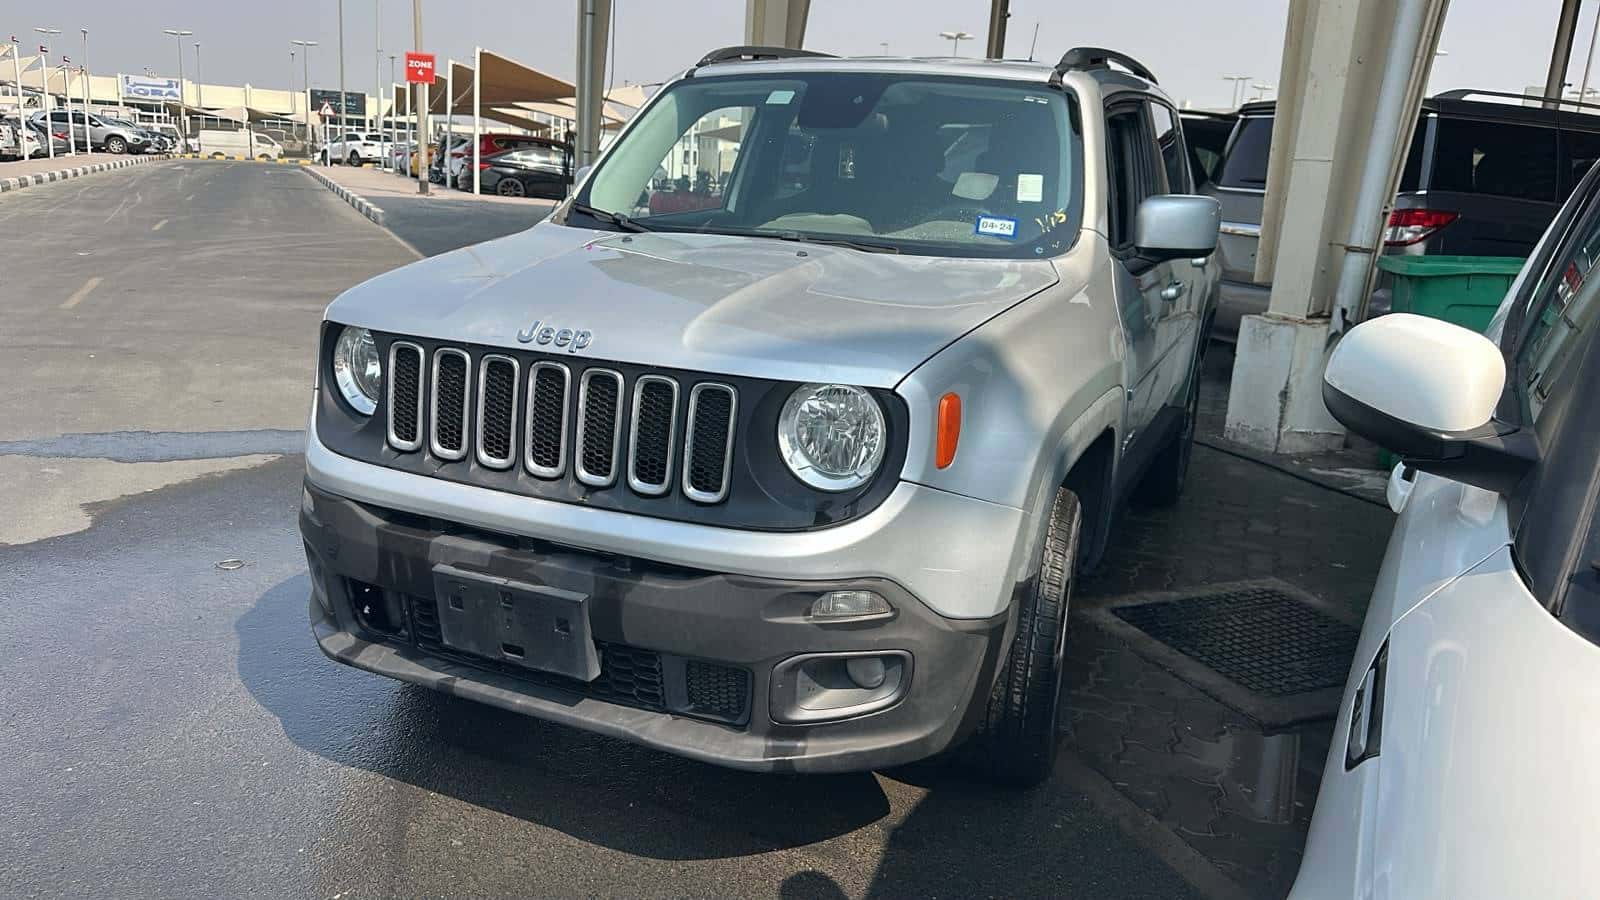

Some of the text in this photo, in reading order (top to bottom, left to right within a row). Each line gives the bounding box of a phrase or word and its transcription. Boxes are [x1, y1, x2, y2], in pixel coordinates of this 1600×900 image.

[408, 59, 433, 69] ZONE
[417, 69, 425, 77] 4
[981, 221, 1012, 231] 04-24
[516, 319, 593, 354] Jeep
